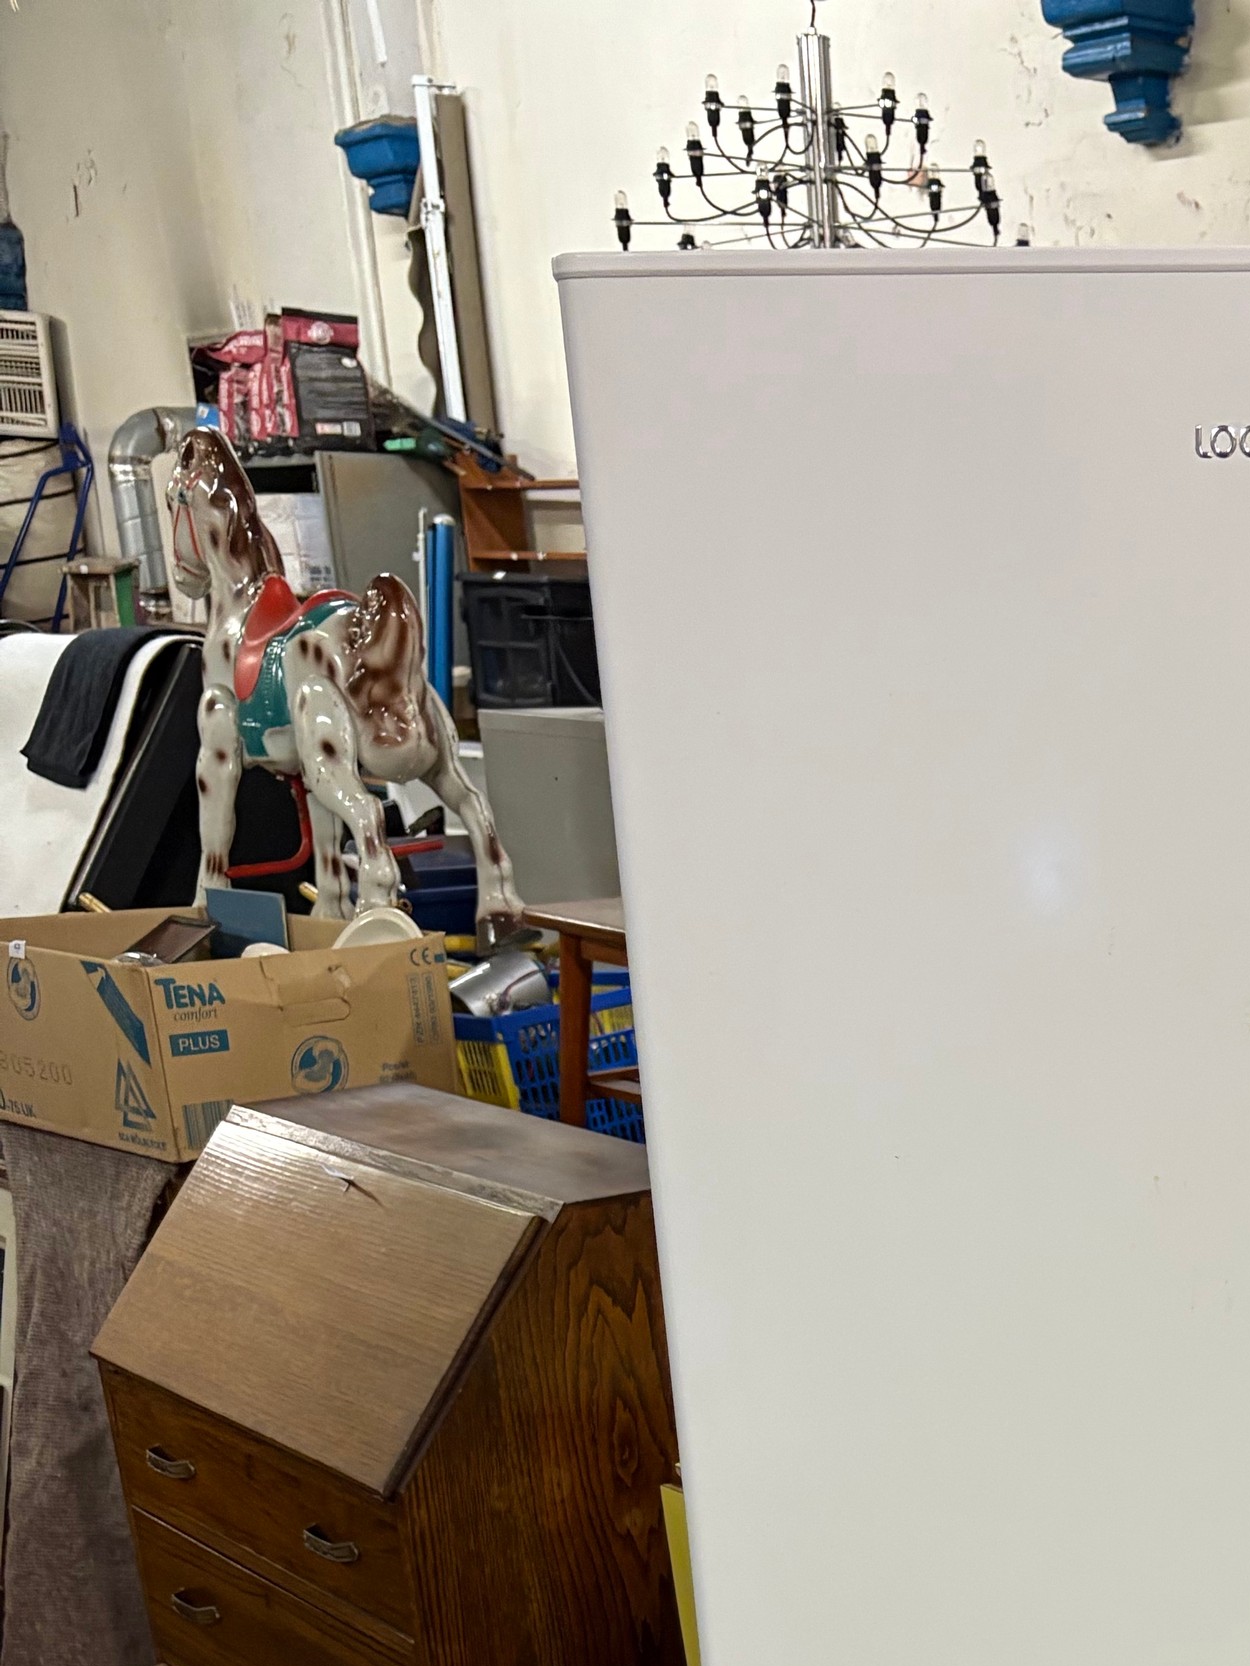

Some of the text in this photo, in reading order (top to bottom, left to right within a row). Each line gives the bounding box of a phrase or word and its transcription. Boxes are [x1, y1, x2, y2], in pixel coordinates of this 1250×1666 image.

[154, 978, 226, 1009] TENA
[174, 1008, 218, 1022] comfort
[179, 1035, 220, 1052] PLUS
